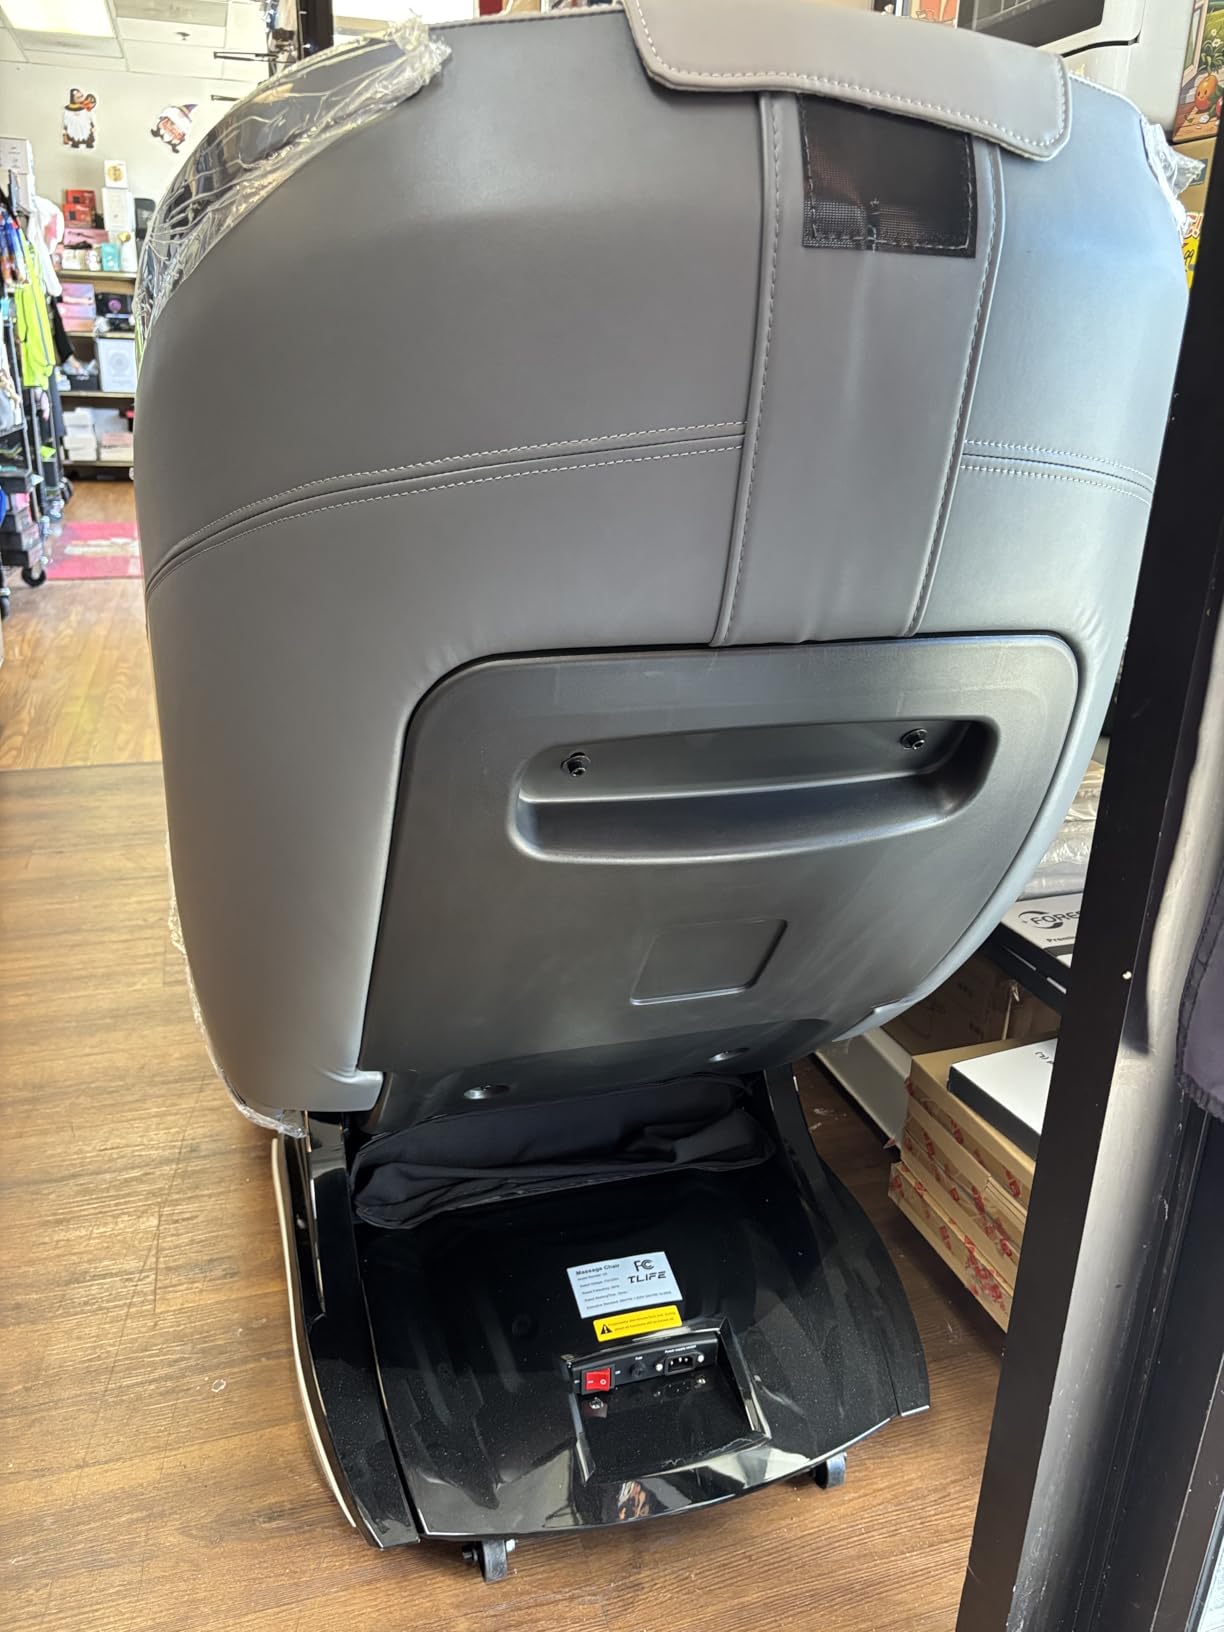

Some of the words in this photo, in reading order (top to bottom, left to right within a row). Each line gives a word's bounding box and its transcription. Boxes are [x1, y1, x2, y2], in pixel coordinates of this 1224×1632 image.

[575, 1266, 603, 1275] Massage
[603, 1263, 620, 1271] Chair
[627, 1270, 667, 1284] TLIFE
